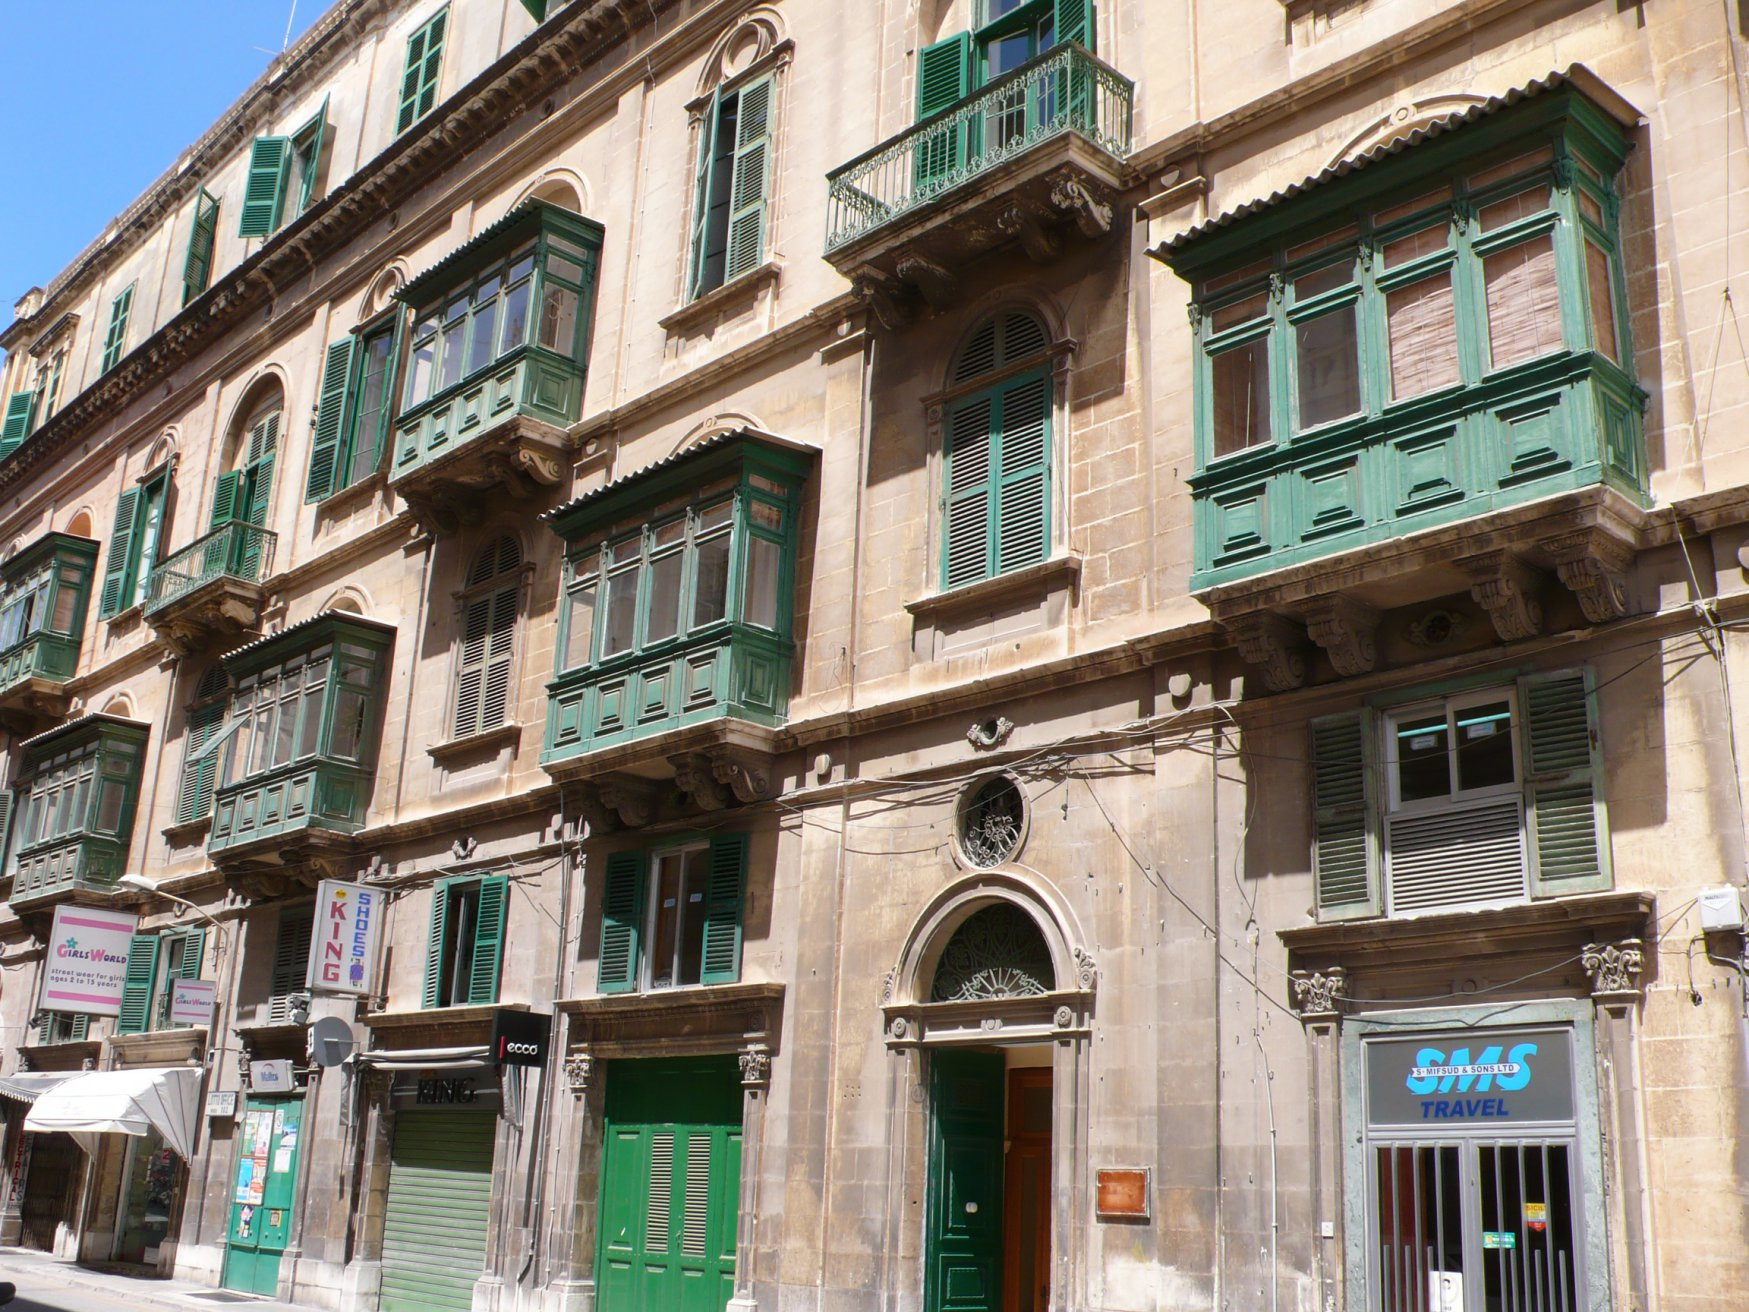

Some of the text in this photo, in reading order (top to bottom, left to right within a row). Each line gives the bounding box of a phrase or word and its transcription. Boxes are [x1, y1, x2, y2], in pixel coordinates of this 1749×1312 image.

[352, 893, 371, 957] SHOES
[323, 901, 348, 982] KING
[57, 945, 127, 964] GIRLS WORLD
[50, 975, 118, 989] ages 2 to 15 years
[51, 968, 126, 983] street wear for girls
[506, 1041, 538, 1056] ecco
[1405, 1042, 1539, 1096] SMS
[1461, 1066, 1468, 1074] &
[1470, 1065, 1495, 1074] SONS
[1497, 1063, 1515, 1073] LTD
[416, 1077, 477, 1105] KING
[1420, 1098, 1510, 1119] TRAVEL
